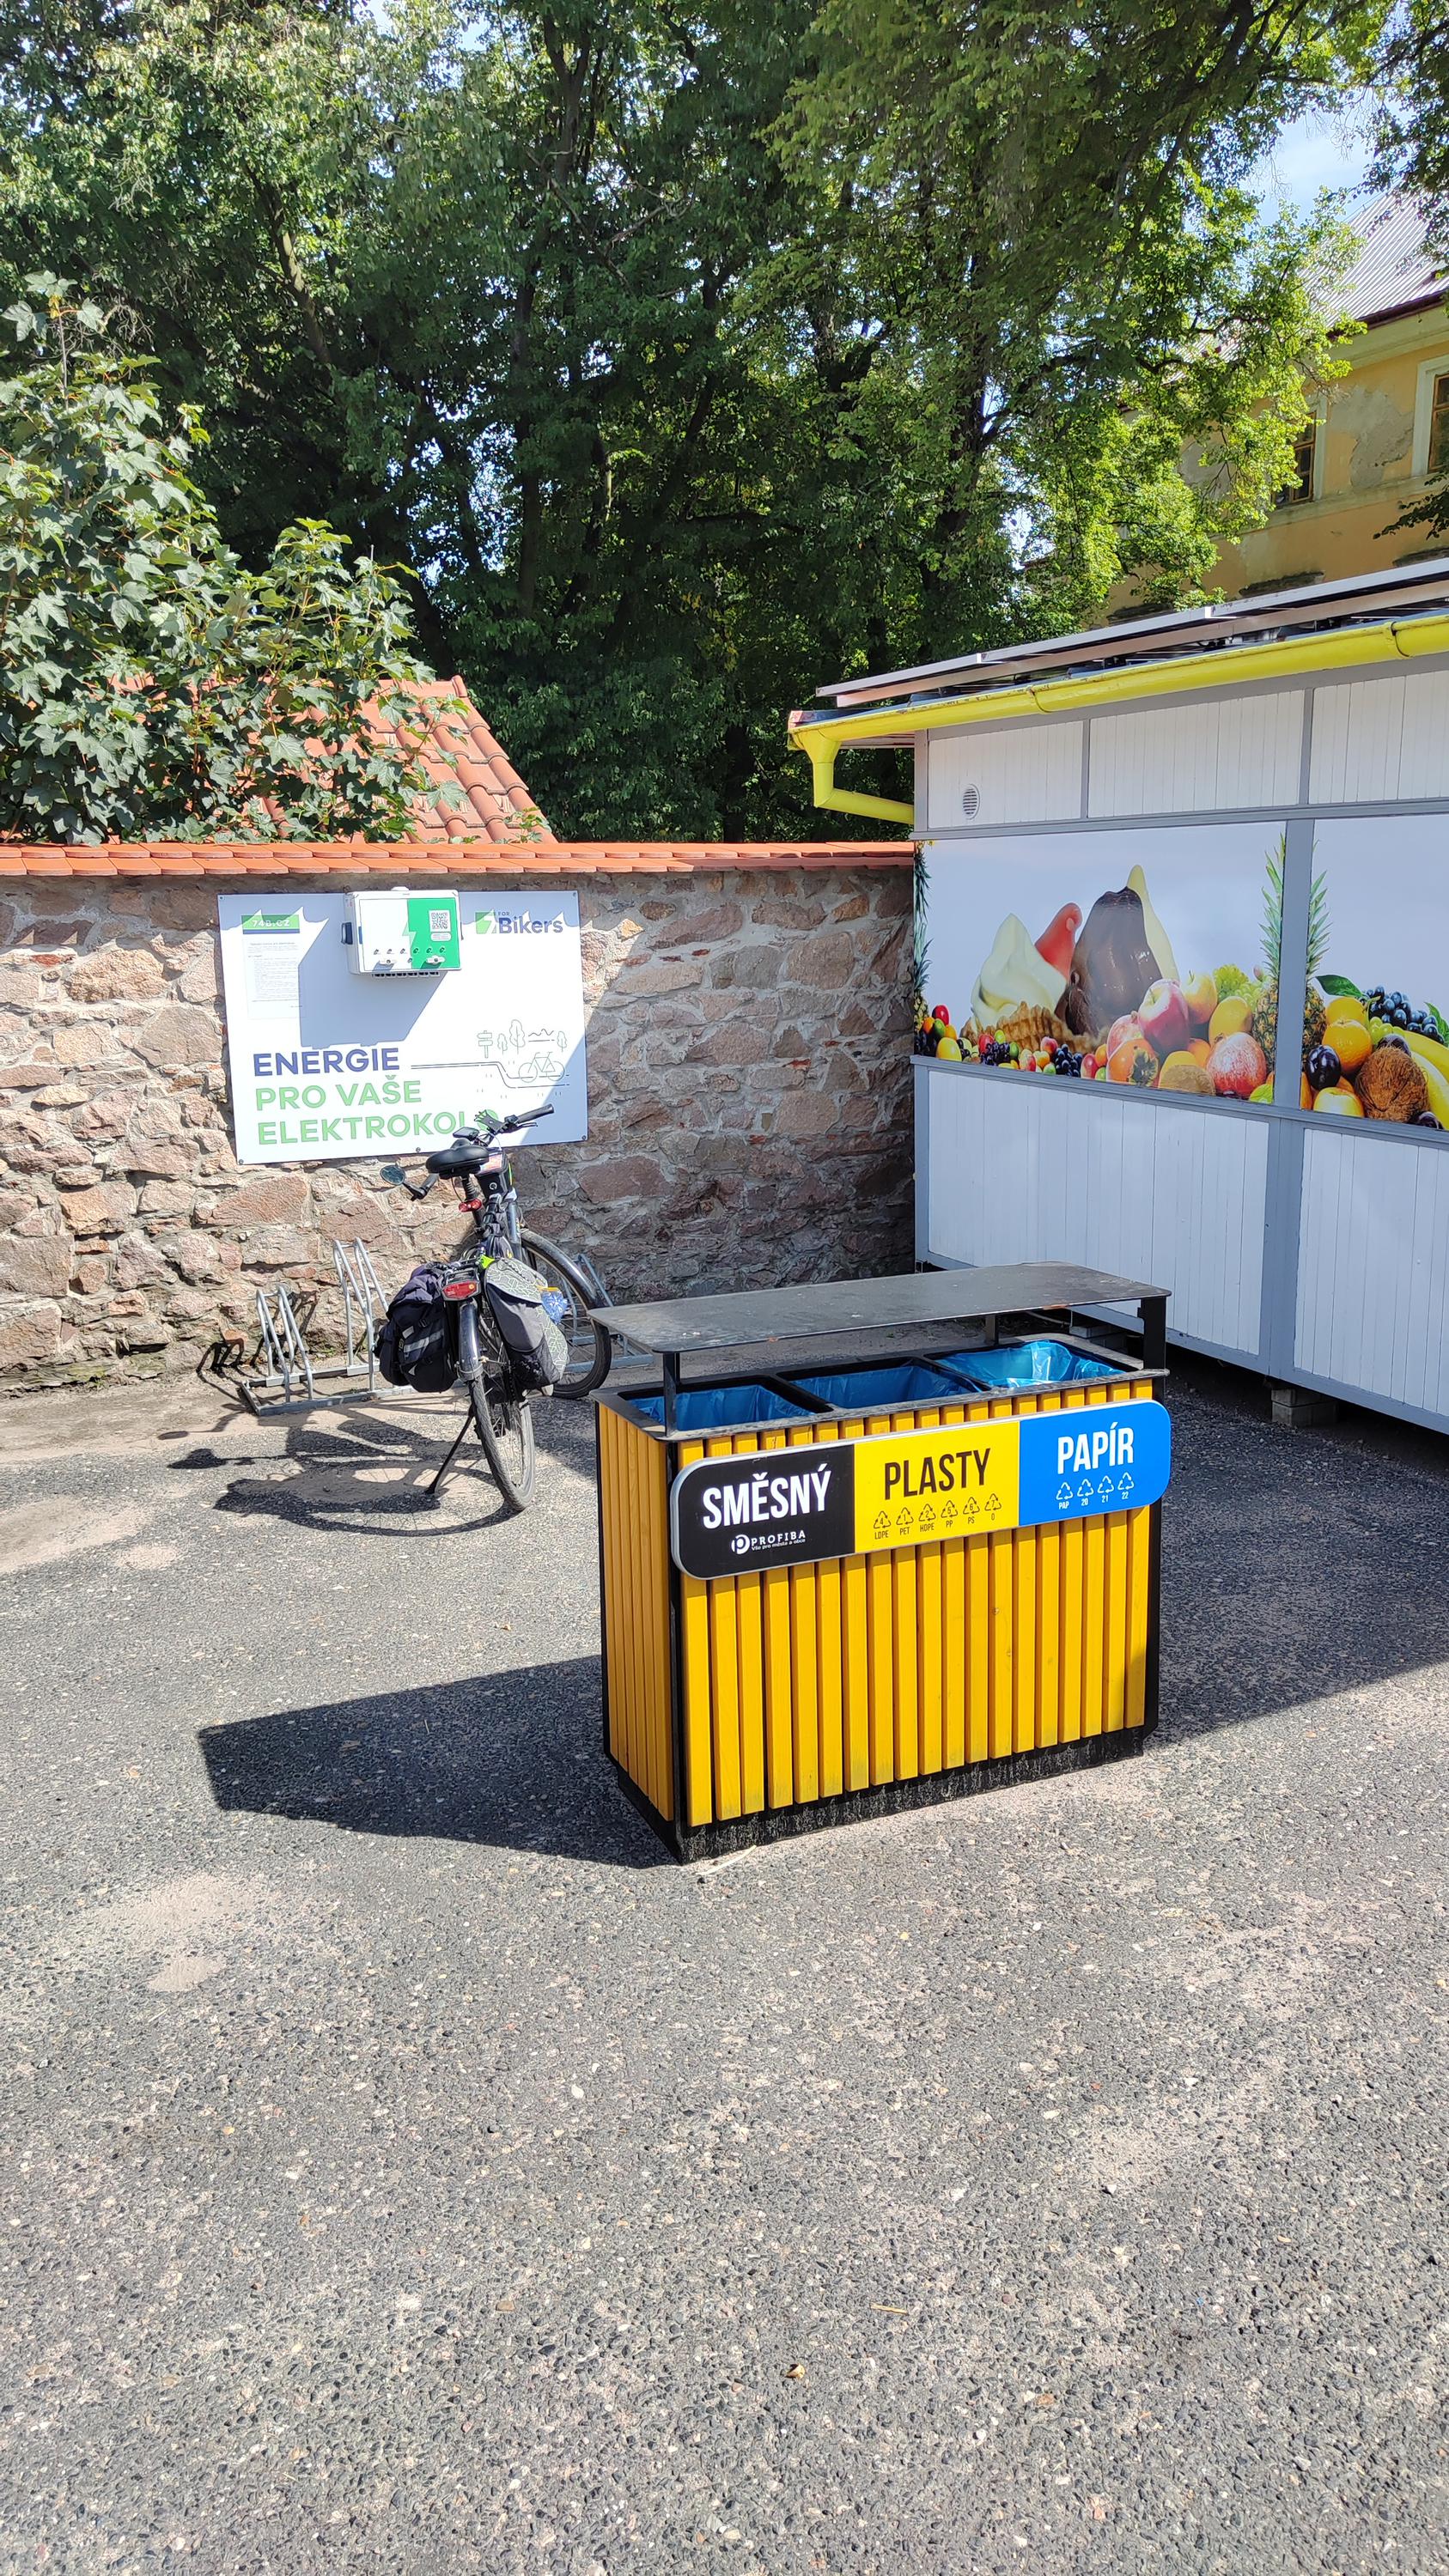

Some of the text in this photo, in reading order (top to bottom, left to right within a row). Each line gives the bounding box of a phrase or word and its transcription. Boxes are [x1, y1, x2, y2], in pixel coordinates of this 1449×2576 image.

[498, 915, 563, 934] Bikers
[253, 1047, 400, 1077] ENERGIE
[255, 1074, 422, 1111] PRO VAŠE
[1057, 1421, 1134, 1474] PAPÍR
[884, 1448, 990, 1501] PLASTY
[703, 1463, 831, 1529] SMĚSNÝ
[1058, 1501, 1069, 1510] PAP
[1081, 1498, 1089, 1506] 20
[1122, 1491, 1129, 1499] 22
[751, 1530, 806, 1546] PROFIBA
[874, 1531, 889, 1540] LDPE
[899, 1527, 910, 1535] PET
[920, 1523, 935, 1532] HDPE
